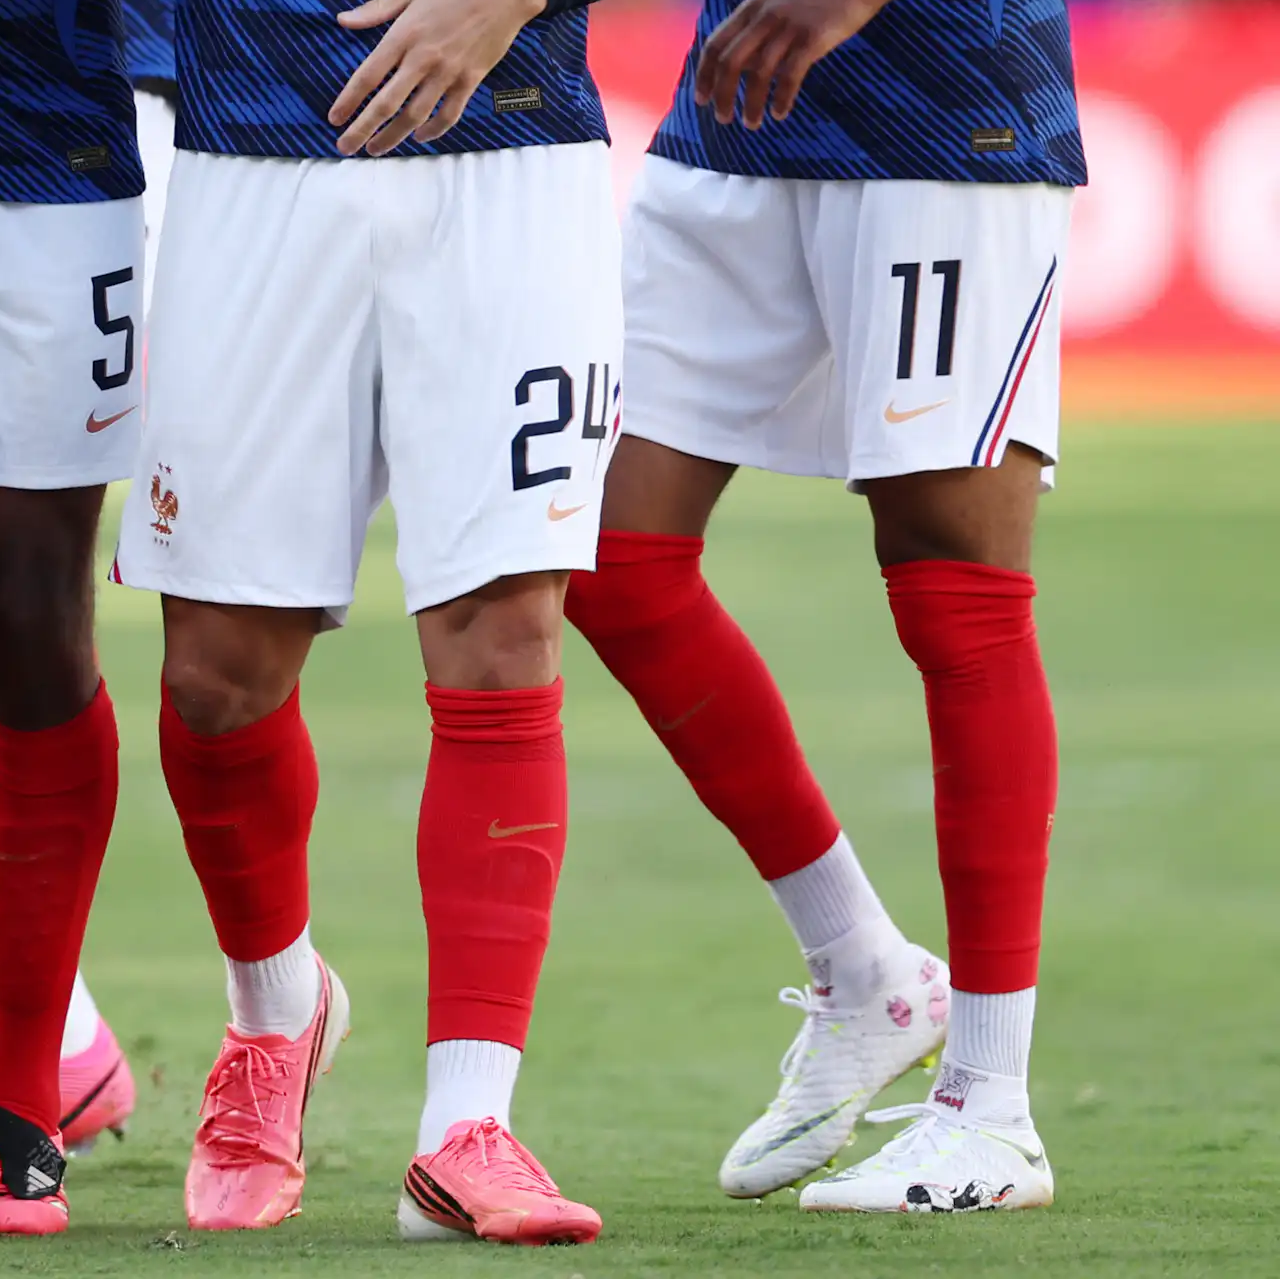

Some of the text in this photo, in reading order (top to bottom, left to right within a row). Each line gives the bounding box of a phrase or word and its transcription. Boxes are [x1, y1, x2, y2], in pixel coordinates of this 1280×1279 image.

[91, 265, 135, 391] 5
[891, 259, 962, 380] 11
[511, 363, 609, 492] 24
